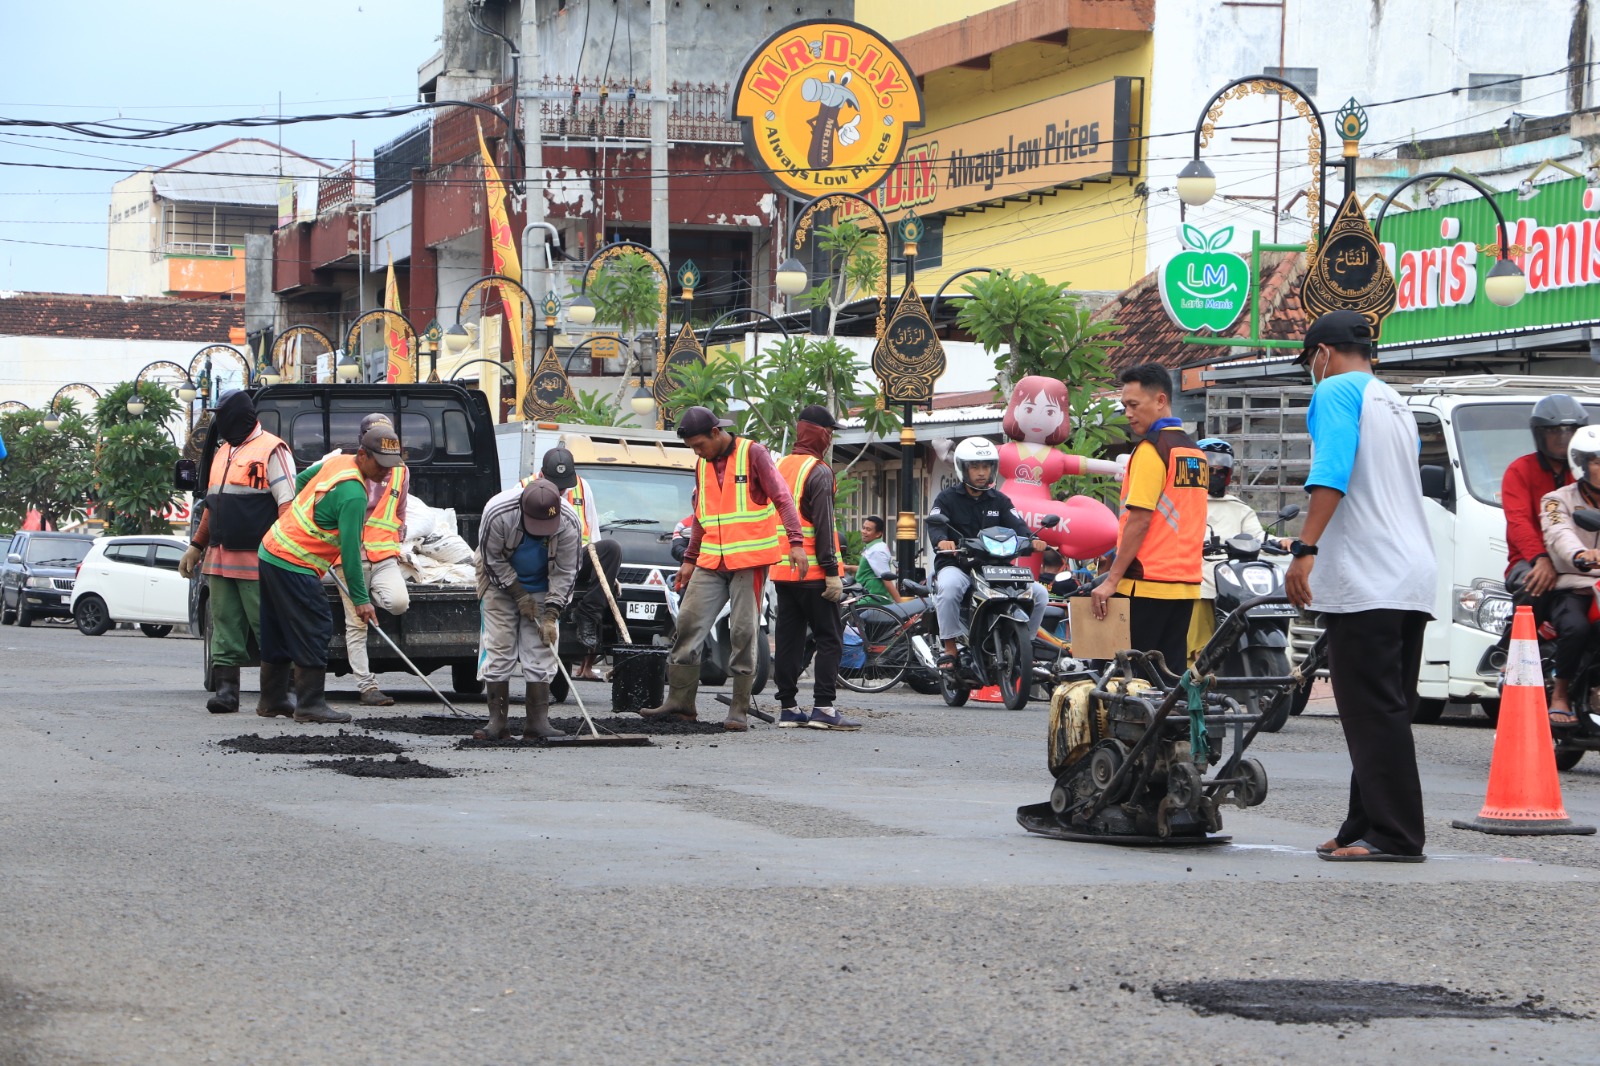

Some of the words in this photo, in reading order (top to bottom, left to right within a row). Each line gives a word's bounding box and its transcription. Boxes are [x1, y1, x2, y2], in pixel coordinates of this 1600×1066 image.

[766, 126, 809, 181] Always
[814, 172, 848, 185] Low
[852, 132, 891, 180] Prices
[946, 144, 1004, 191] Always
[1008, 135, 1042, 175] Low
[1045, 120, 1100, 165] Prices
[1187, 263, 1227, 287] LM
[1379, 217, 1474, 311] aris
[1181, 298, 1204, 308] Laris
[1205, 298, 1234, 309] Manis
[629, 603, 639, 614] AE
[644, 604, 658, 614] 80
